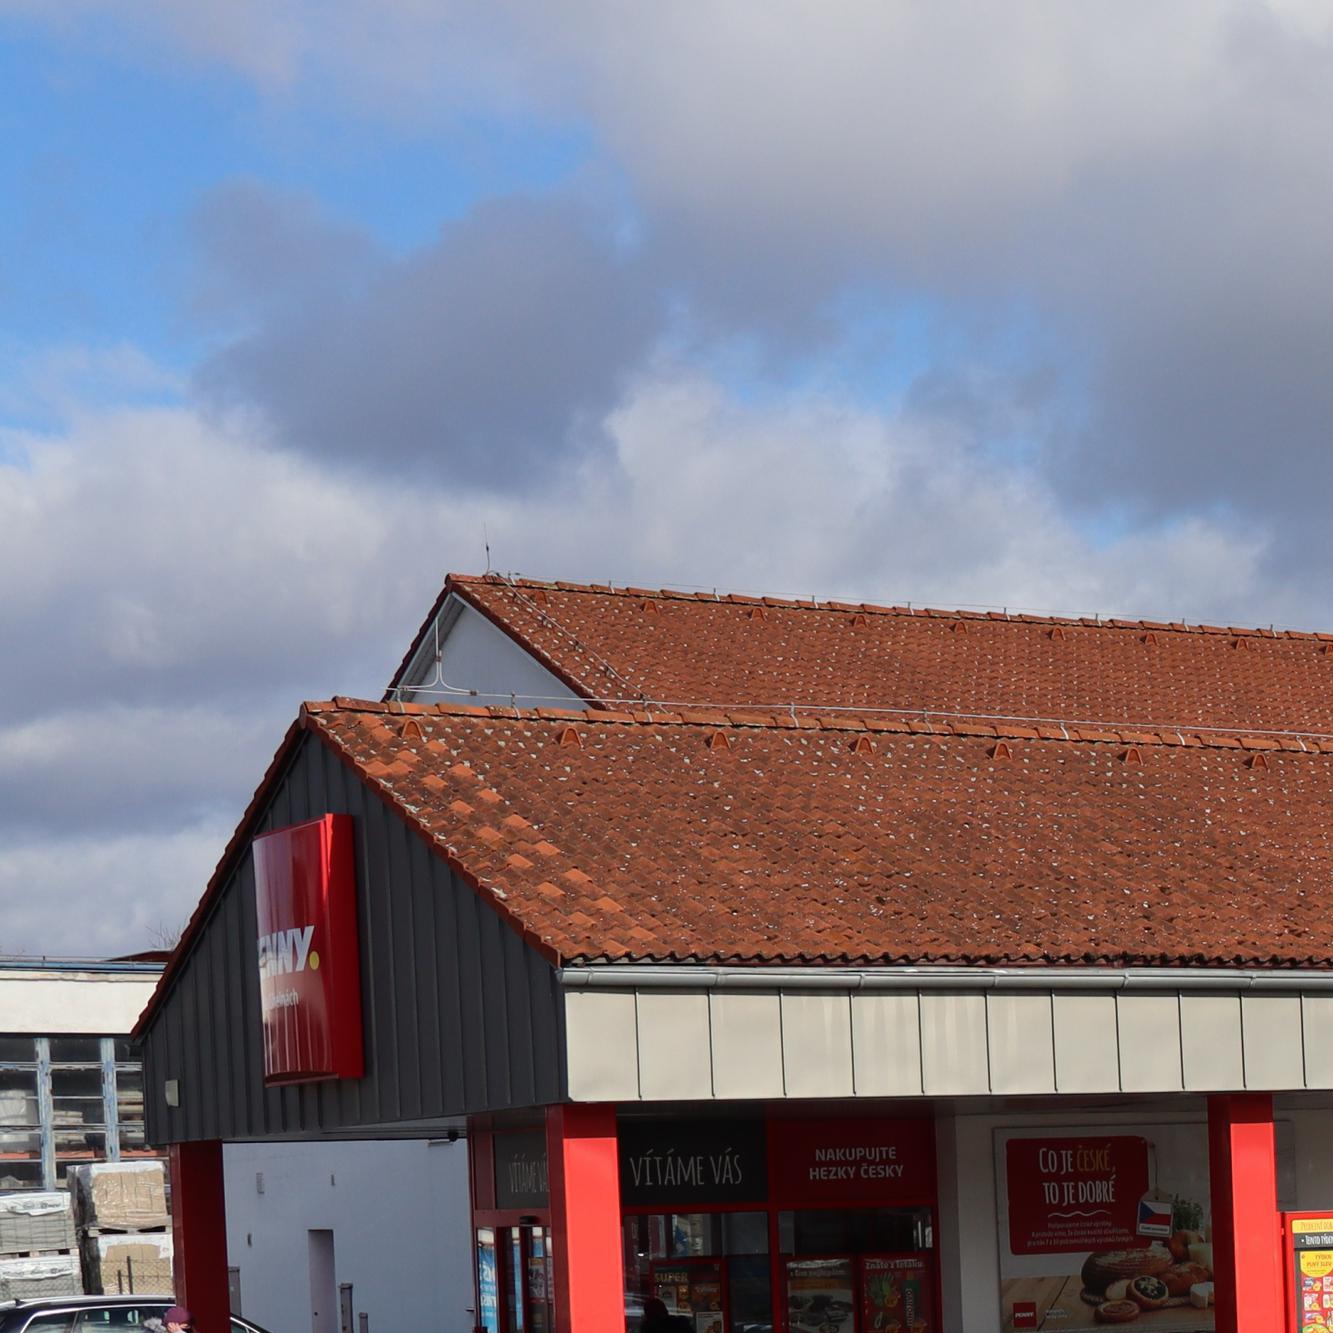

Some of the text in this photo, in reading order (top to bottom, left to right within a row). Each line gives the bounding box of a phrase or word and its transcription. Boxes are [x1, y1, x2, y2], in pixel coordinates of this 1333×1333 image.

[630, 1147, 743, 1186] VÍTÁME VÁS
[815, 1147, 897, 1162] NAKUPUJTE
[1060, 1150, 1074, 1175] JE
[539, 1152, 550, 1193] VÁ
[809, 1163, 904, 1180] HEZKY ČESKY
[1042, 1175, 1116, 1206] TO JE DOBRÉ
[655, 1272, 688, 1282] SUPER
